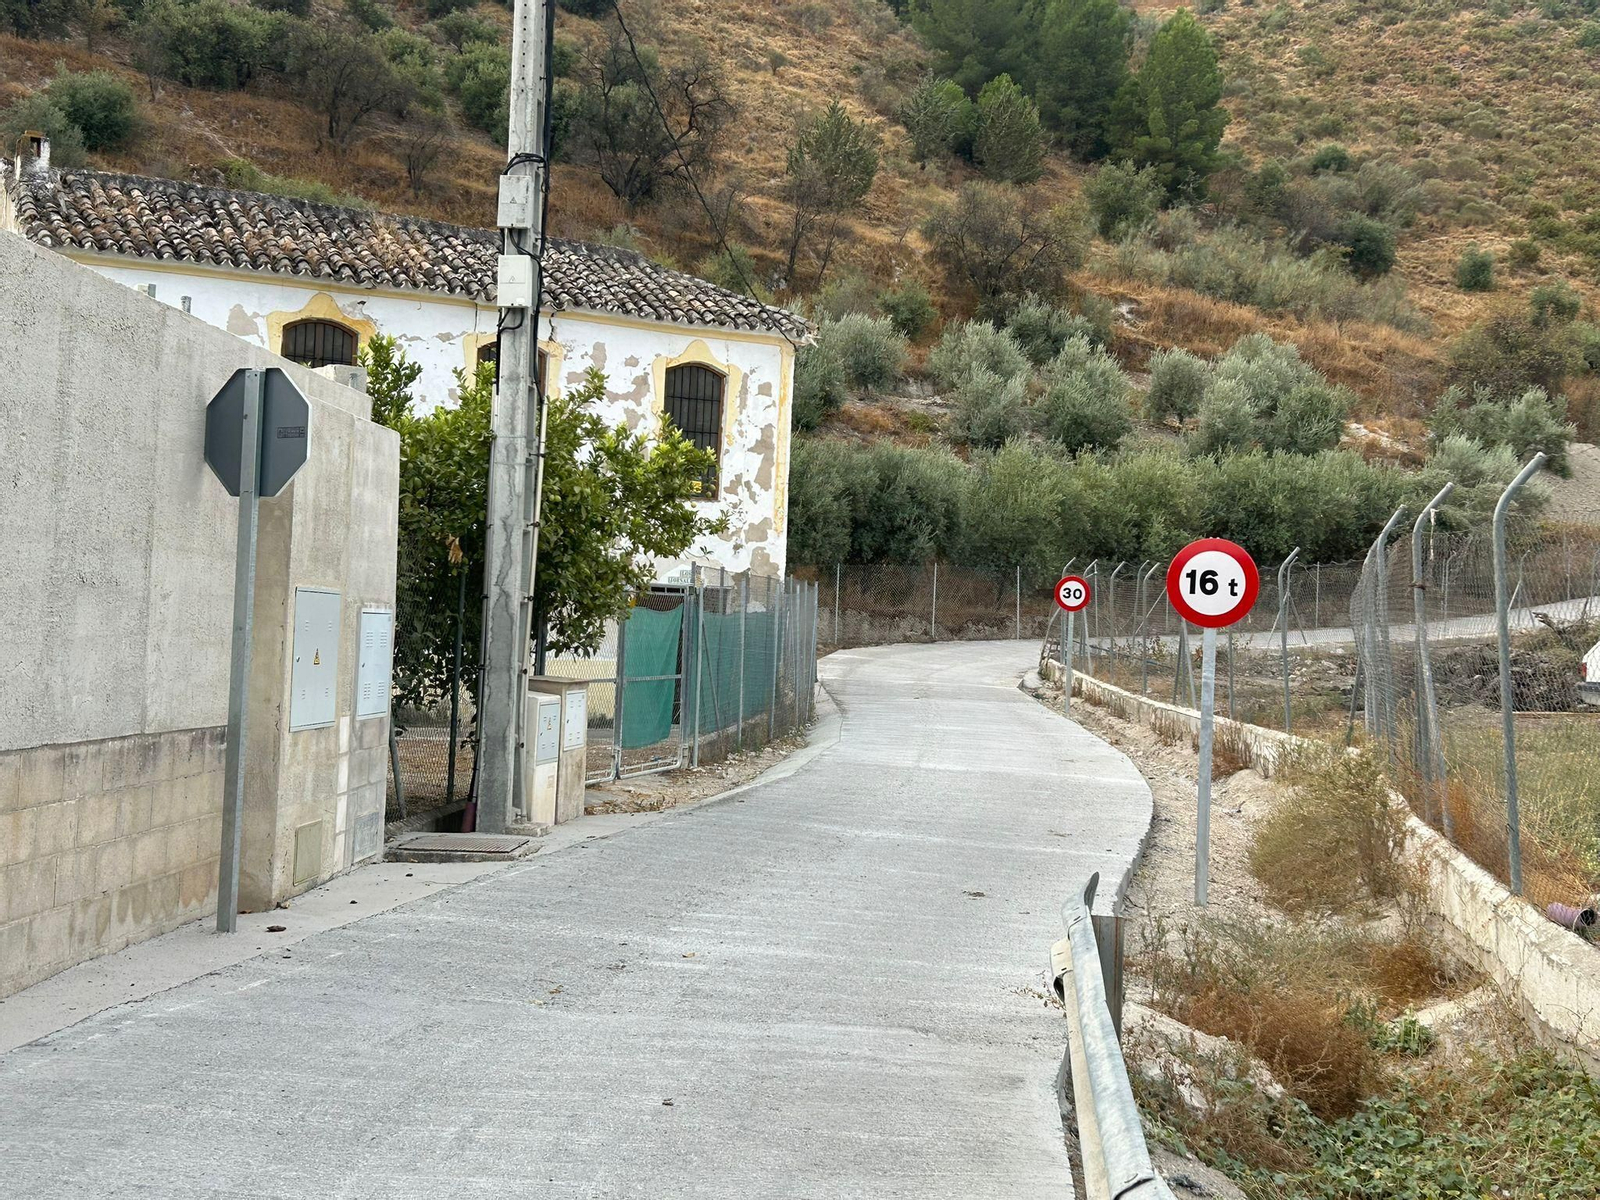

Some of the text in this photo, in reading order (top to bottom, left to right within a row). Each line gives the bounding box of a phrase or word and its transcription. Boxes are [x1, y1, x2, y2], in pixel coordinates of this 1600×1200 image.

[1186, 570, 1238, 596] 16 t
[1062, 588, 1082, 599] 30
